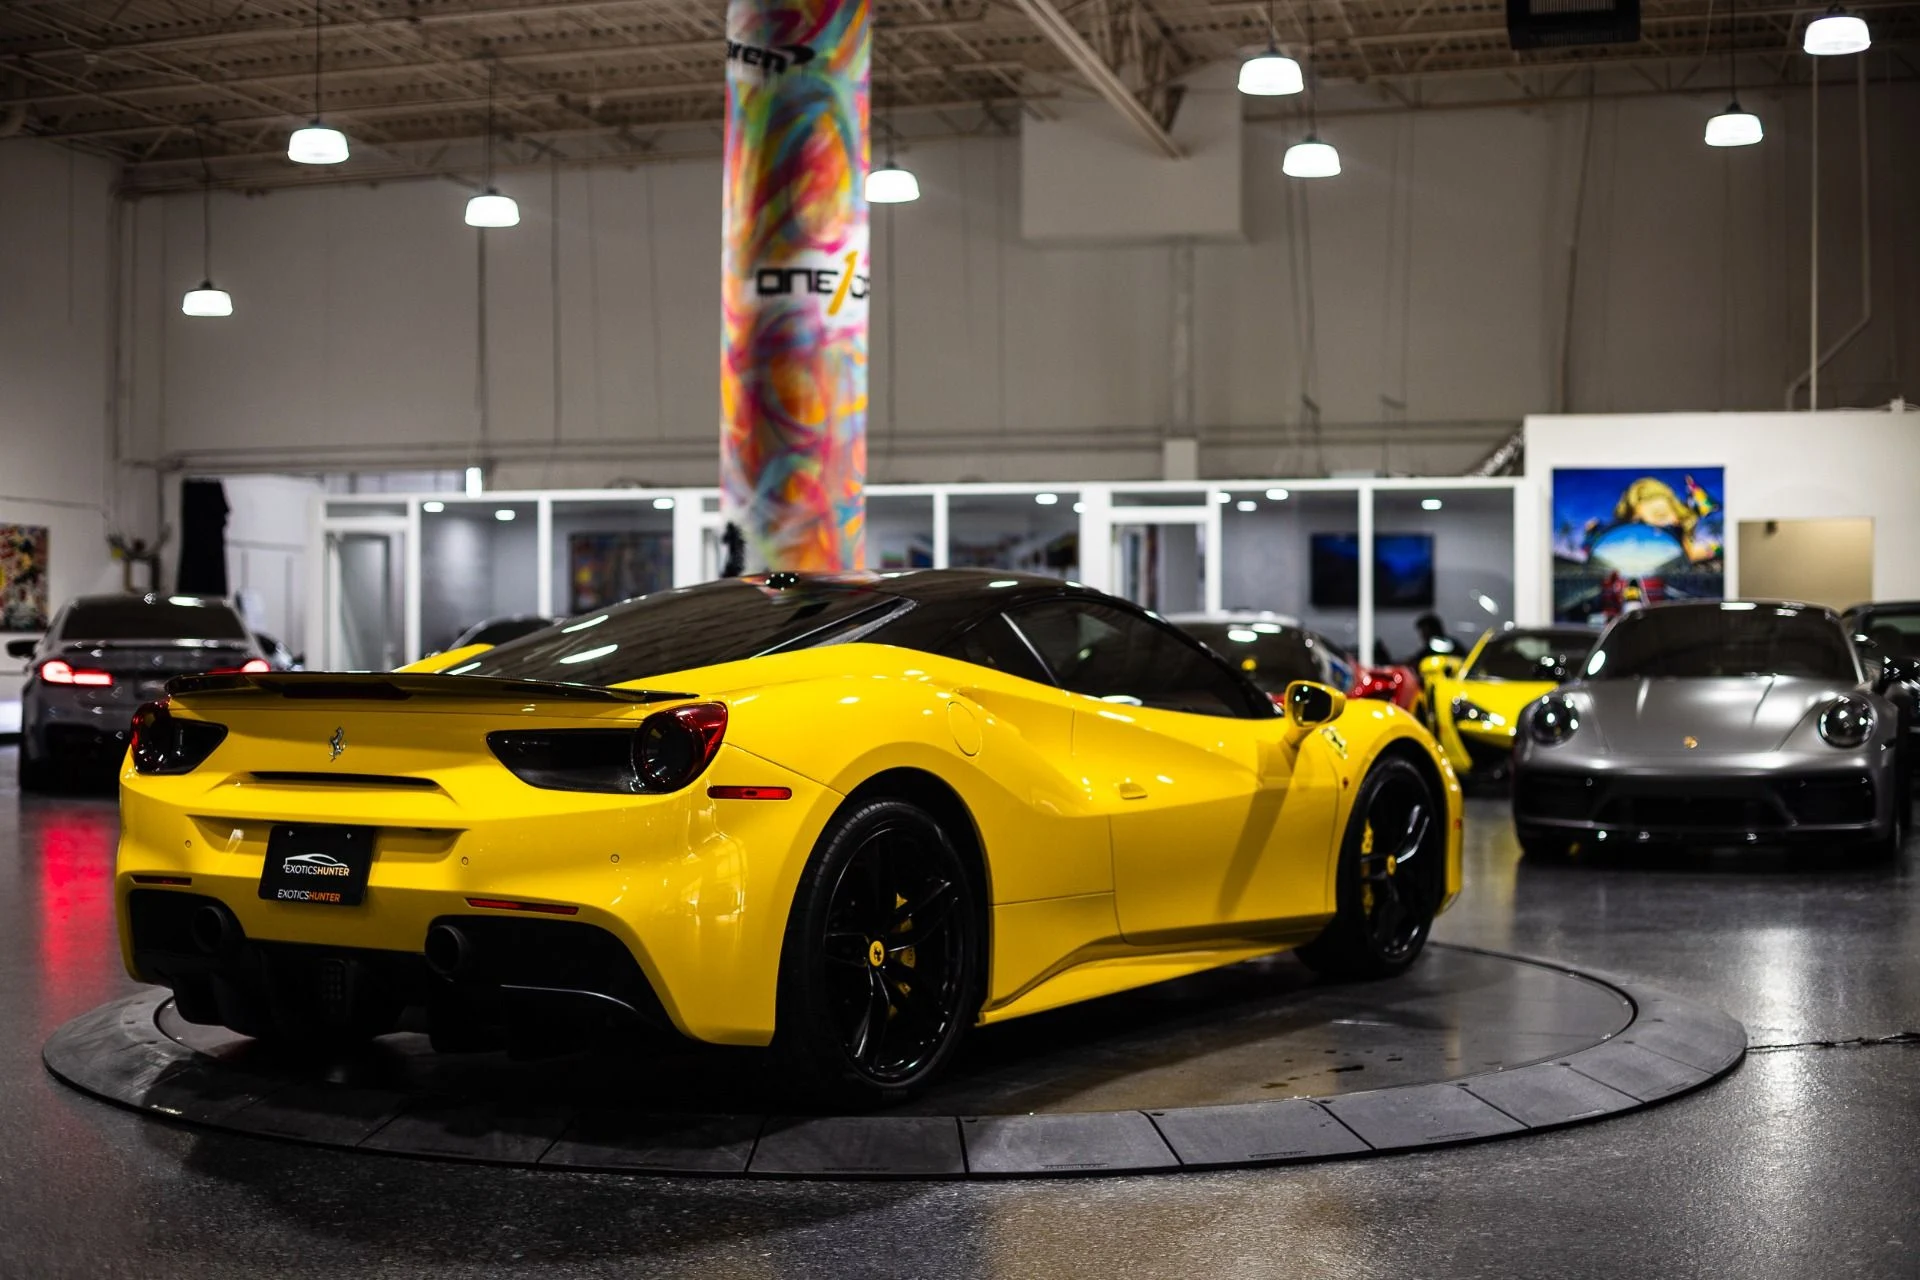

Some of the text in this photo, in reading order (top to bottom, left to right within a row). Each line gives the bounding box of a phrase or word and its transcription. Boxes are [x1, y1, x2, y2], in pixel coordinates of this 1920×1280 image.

[728, 41, 787, 75] ren
[284, 864, 350, 876] EXOTICSHUNTER
[277, 889, 341, 902] EXOTICSHUNTER
